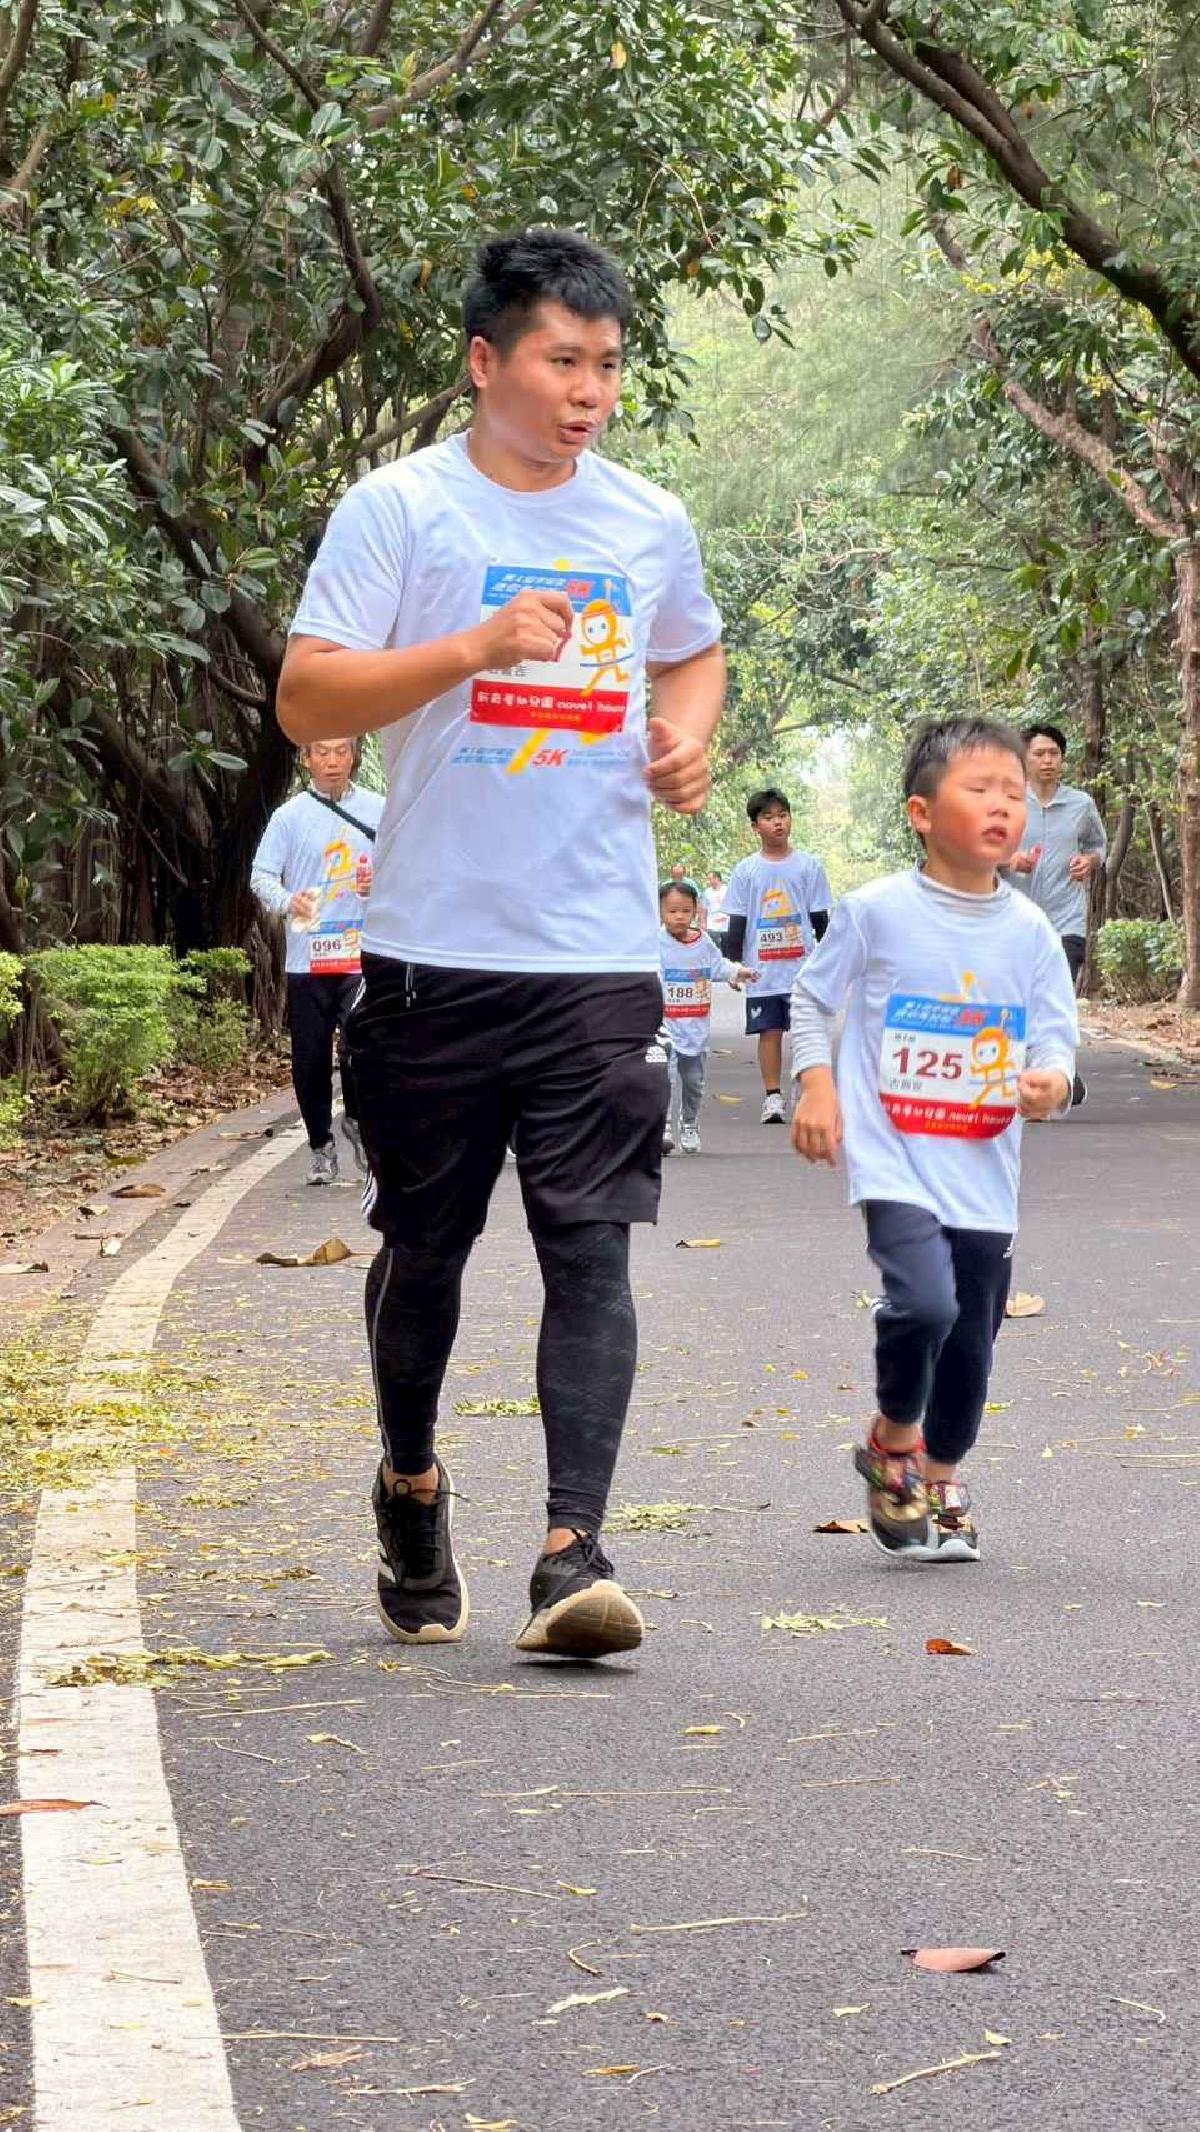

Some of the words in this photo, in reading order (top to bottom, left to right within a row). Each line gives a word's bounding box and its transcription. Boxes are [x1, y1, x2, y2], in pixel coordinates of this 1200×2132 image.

[532, 748, 569, 767] 5K
[667, 987, 693, 998] 188
[892, 1047, 963, 1080] 125
